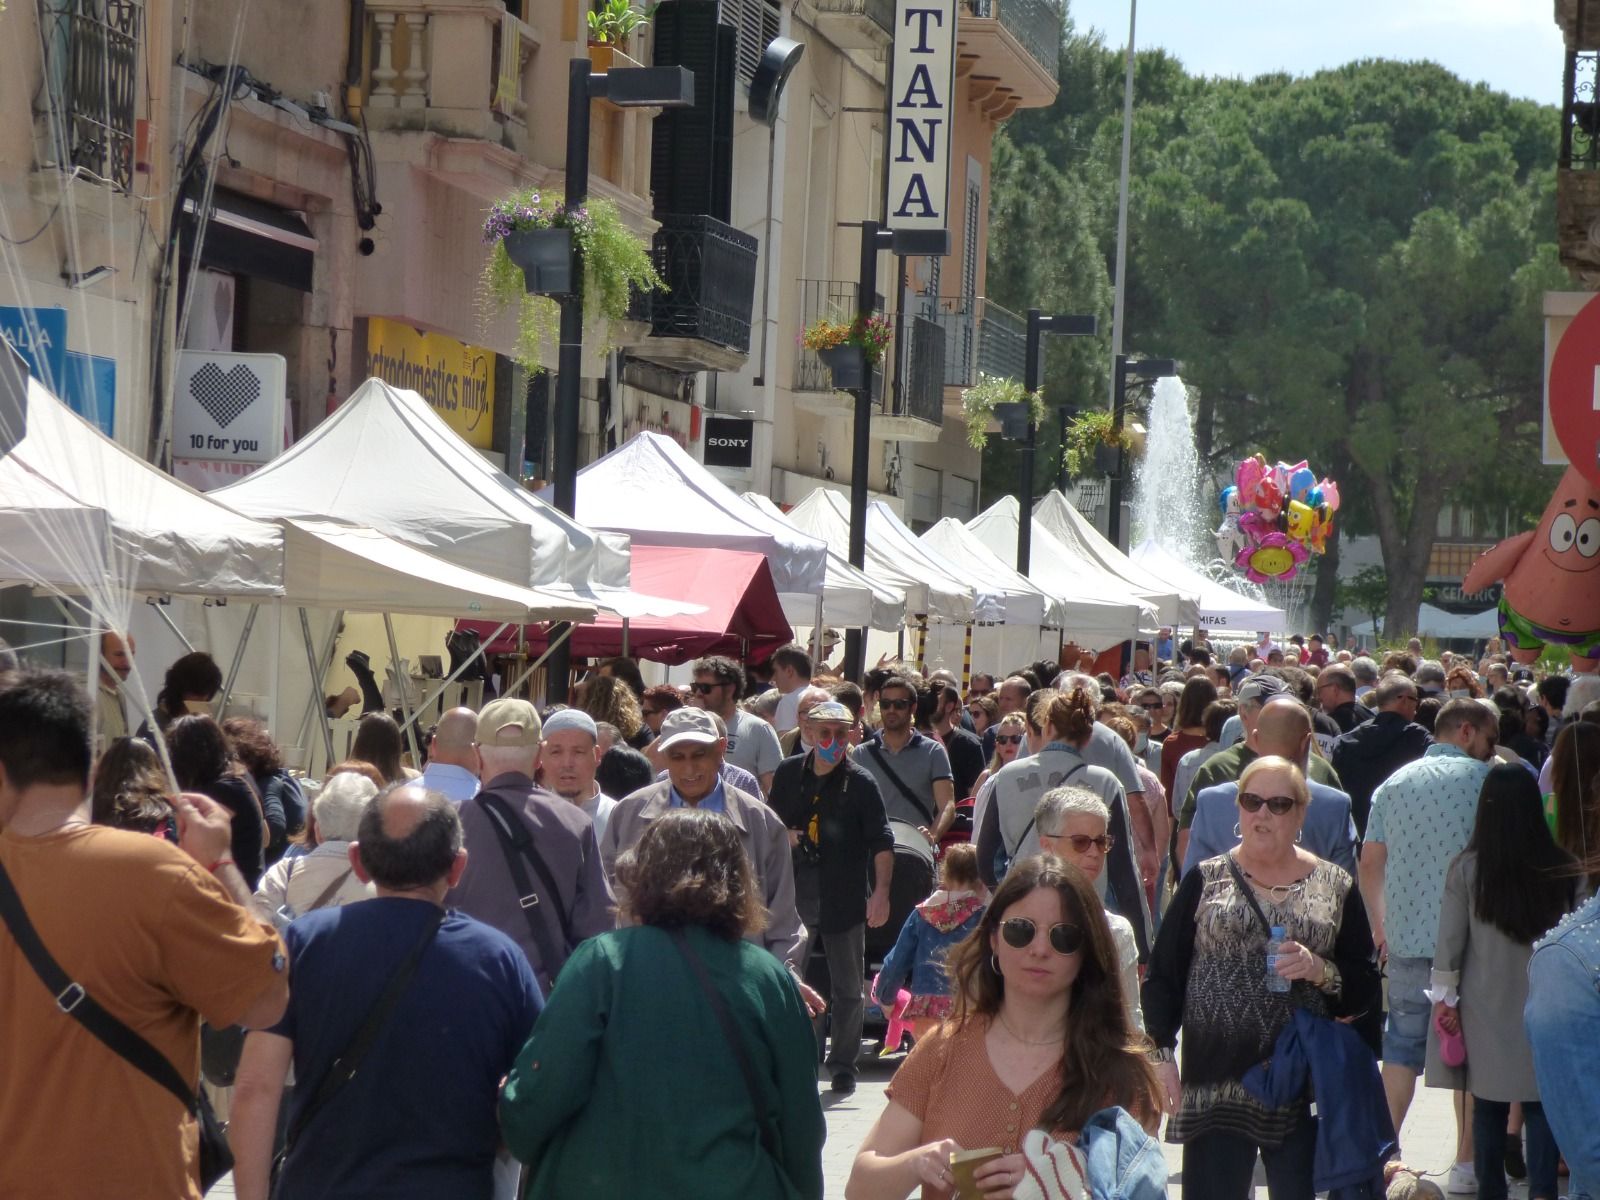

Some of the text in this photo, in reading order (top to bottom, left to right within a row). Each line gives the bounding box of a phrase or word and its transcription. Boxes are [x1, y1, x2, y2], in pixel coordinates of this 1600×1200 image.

[893, 8, 944, 218] TANA
[190, 434, 259, 454] 10 for you
[708, 437, 749, 448] SONY
